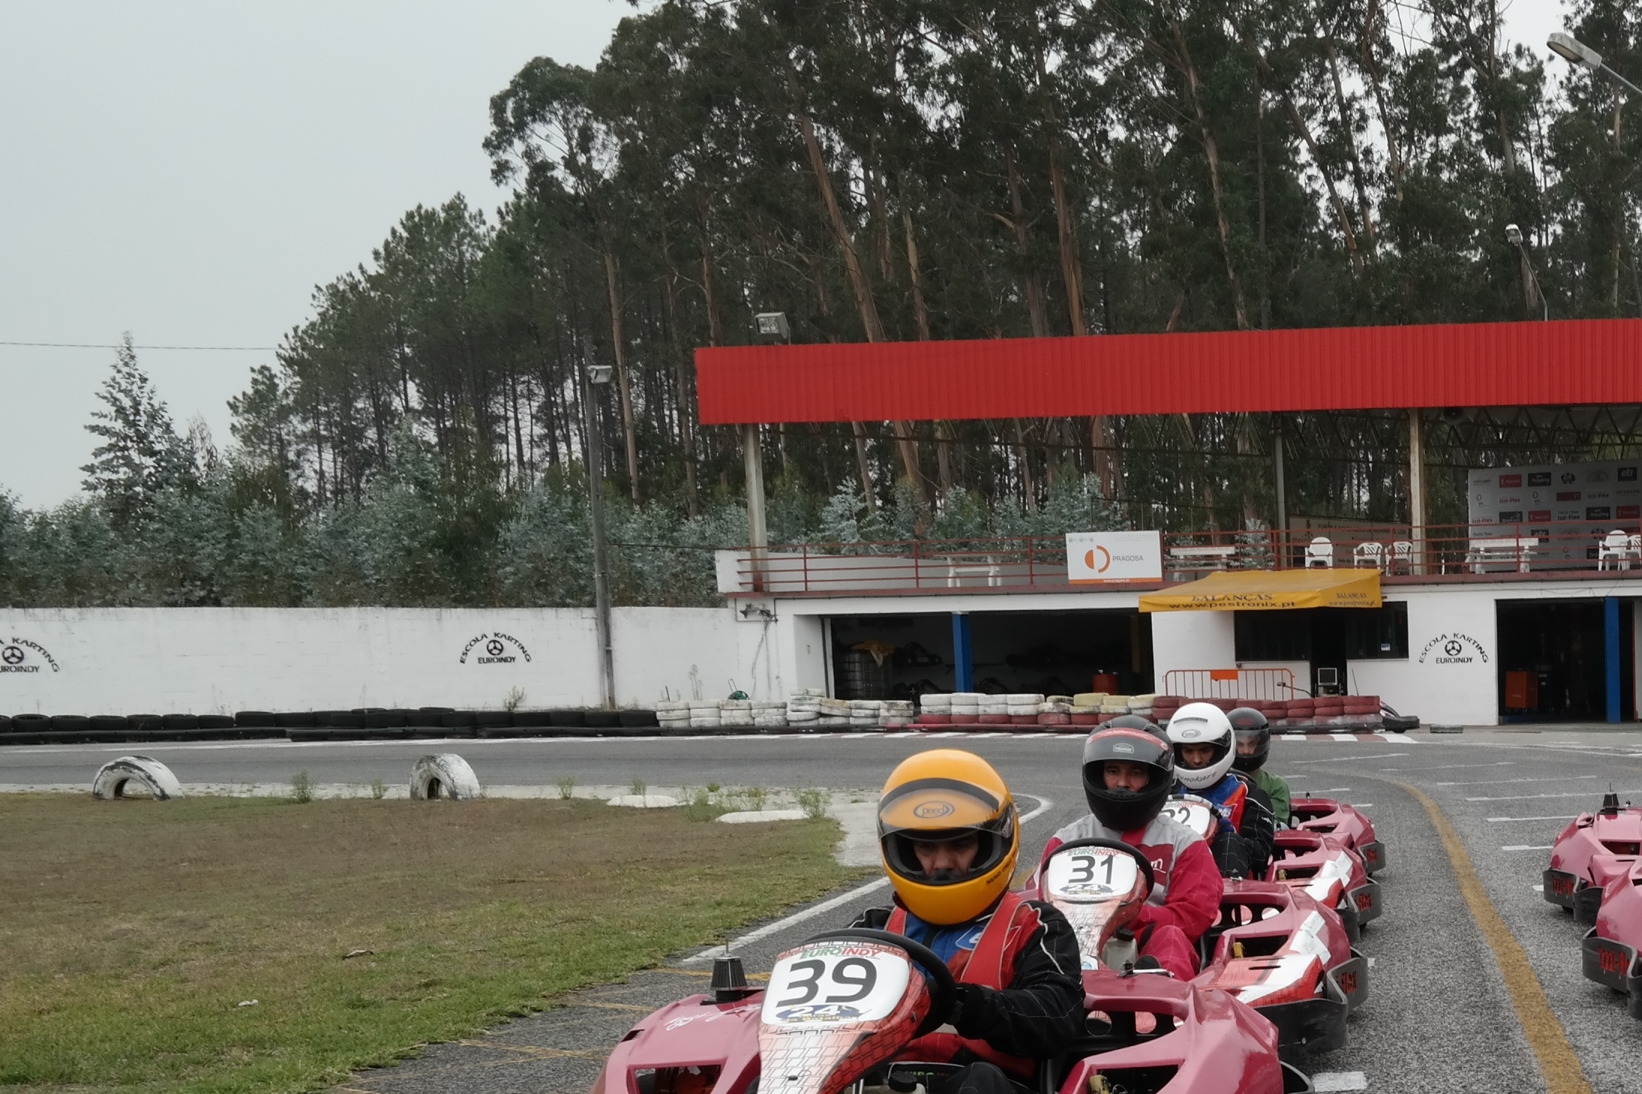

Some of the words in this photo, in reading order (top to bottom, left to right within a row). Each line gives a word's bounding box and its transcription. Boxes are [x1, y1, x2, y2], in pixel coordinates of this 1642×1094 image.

[1112, 554, 1144, 562] PRAGOSA
[1169, 601, 1297, 609] www.pestronix.pt
[12, 637, 61, 672] KARTING
[459, 633, 489, 664] ESCOLA
[494, 632, 532, 662] KARTING
[1419, 633, 1448, 664] ESCOLA
[1453, 632, 1489, 663] KARTING
[478, 656, 516, 664] EUROINDY
[1435, 656, 1474, 664] EUROINDY
[1068, 854, 1113, 884] 31
[799, 946, 882, 960] EUROINDY
[776, 957, 877, 1008] 39
[787, 1005, 841, 1018] 24
